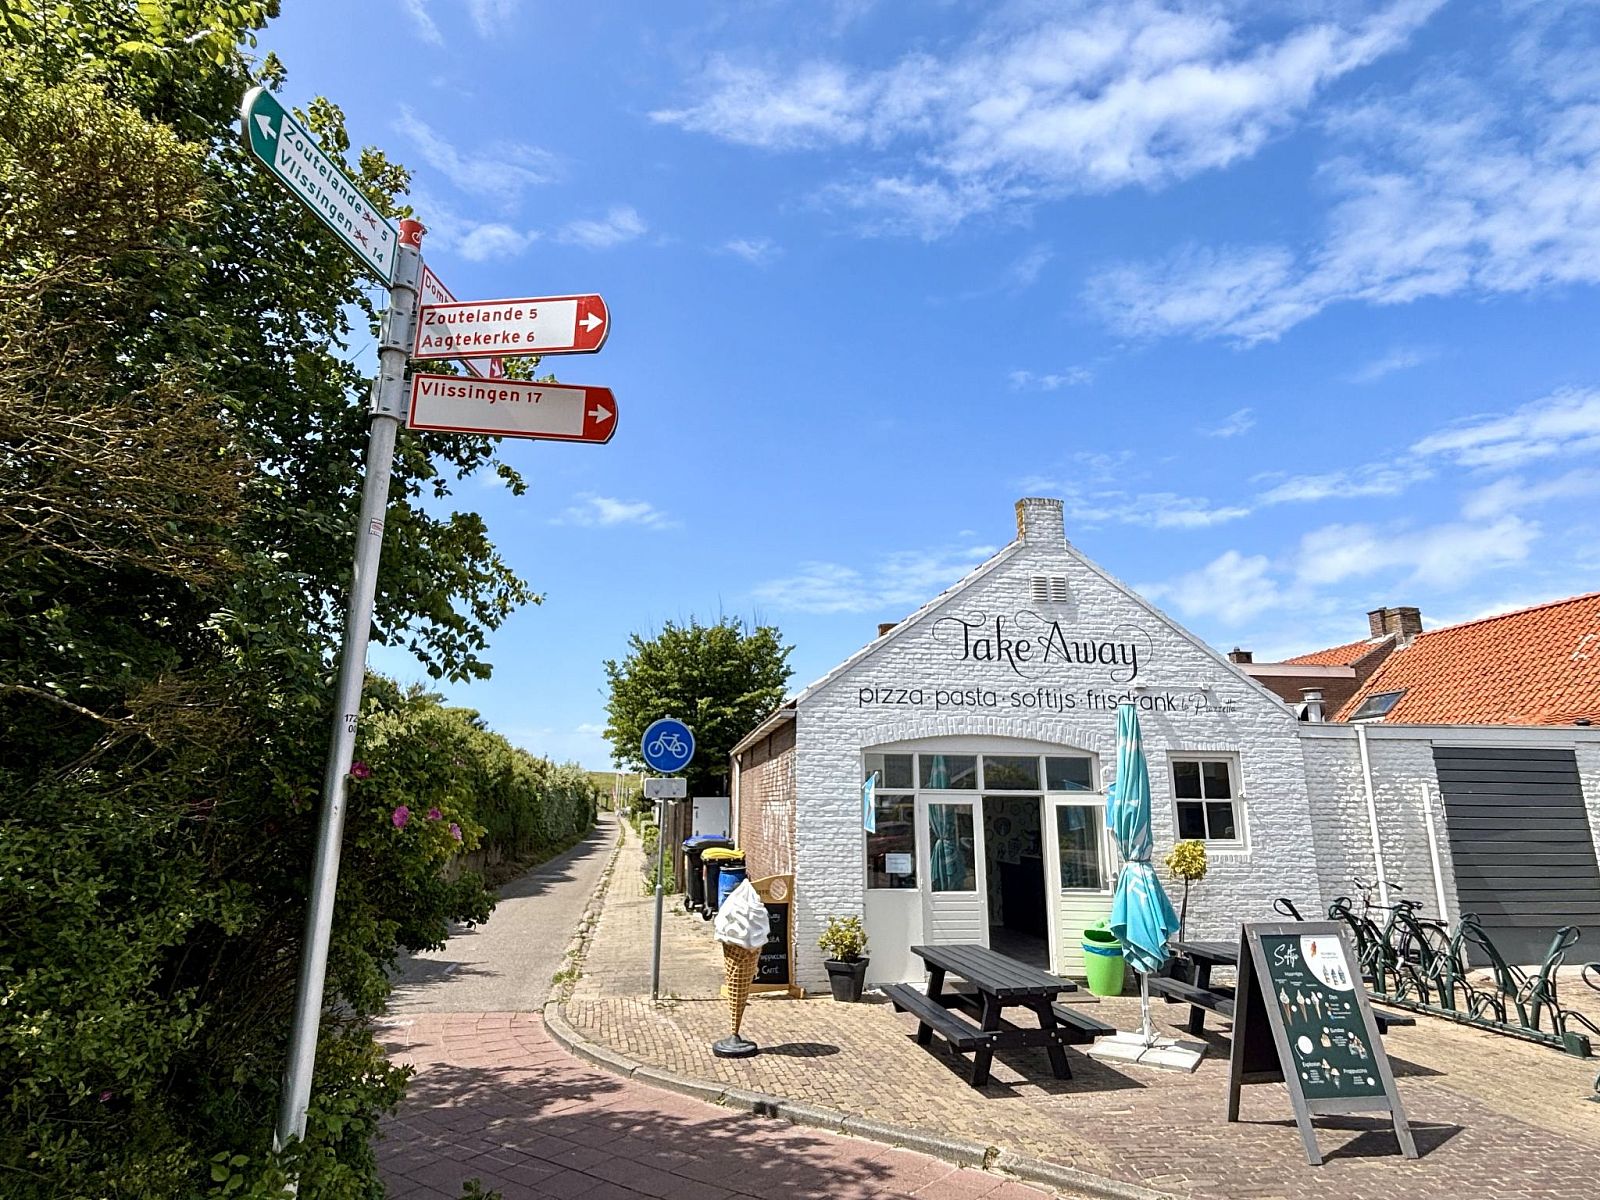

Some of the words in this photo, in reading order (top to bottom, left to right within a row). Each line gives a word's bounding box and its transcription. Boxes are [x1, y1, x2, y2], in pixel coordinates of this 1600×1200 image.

[283, 124, 362, 214] Zoutelande
[381, 230, 388, 242] 5
[280, 149, 353, 232] Vlissingen
[372, 247, 385, 264] 14
[425, 307, 523, 326] Zoutelande
[529, 308, 538, 320] 5
[421, 330, 521, 351] Aagtekerke
[526, 331, 535, 343] 6
[421, 381, 520, 404] Vlissingen
[527, 392, 543, 403] 17
[932, 610, 1045, 678] Take
[1014, 609, 1153, 682] Away
[859, 682, 923, 708] pizza
[935, 687, 997, 711] pasta
[1010, 687, 1076, 712] softijs
[1087, 689, 1177, 711] frisdrank
